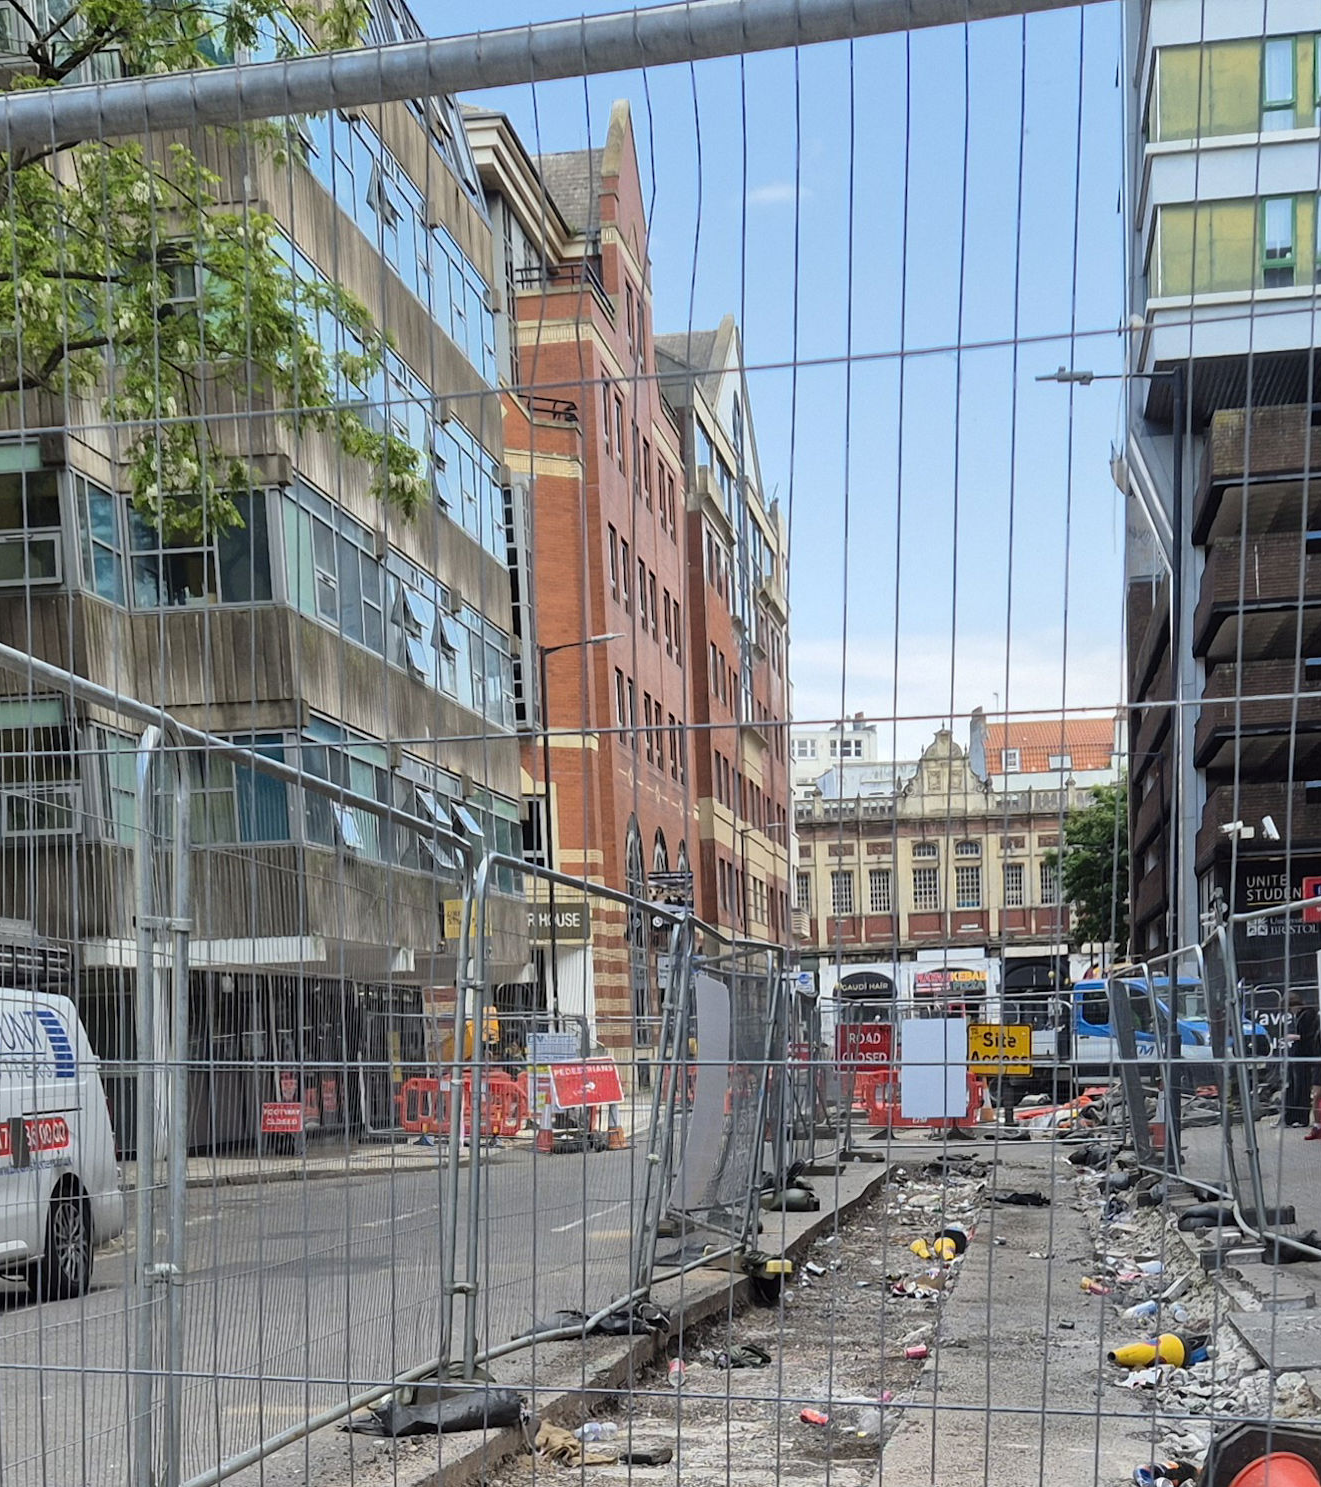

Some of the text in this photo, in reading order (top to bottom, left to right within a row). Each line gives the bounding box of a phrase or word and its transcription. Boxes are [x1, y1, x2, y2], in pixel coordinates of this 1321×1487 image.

[1246, 874, 1290, 888] UNITE
[1246, 887, 1302, 902] STUDEN
[849, 1032, 881, 1045] ROAD
[983, 1032, 1016, 1048] Site
[554, 1065, 614, 1077] PEDESRIANS
